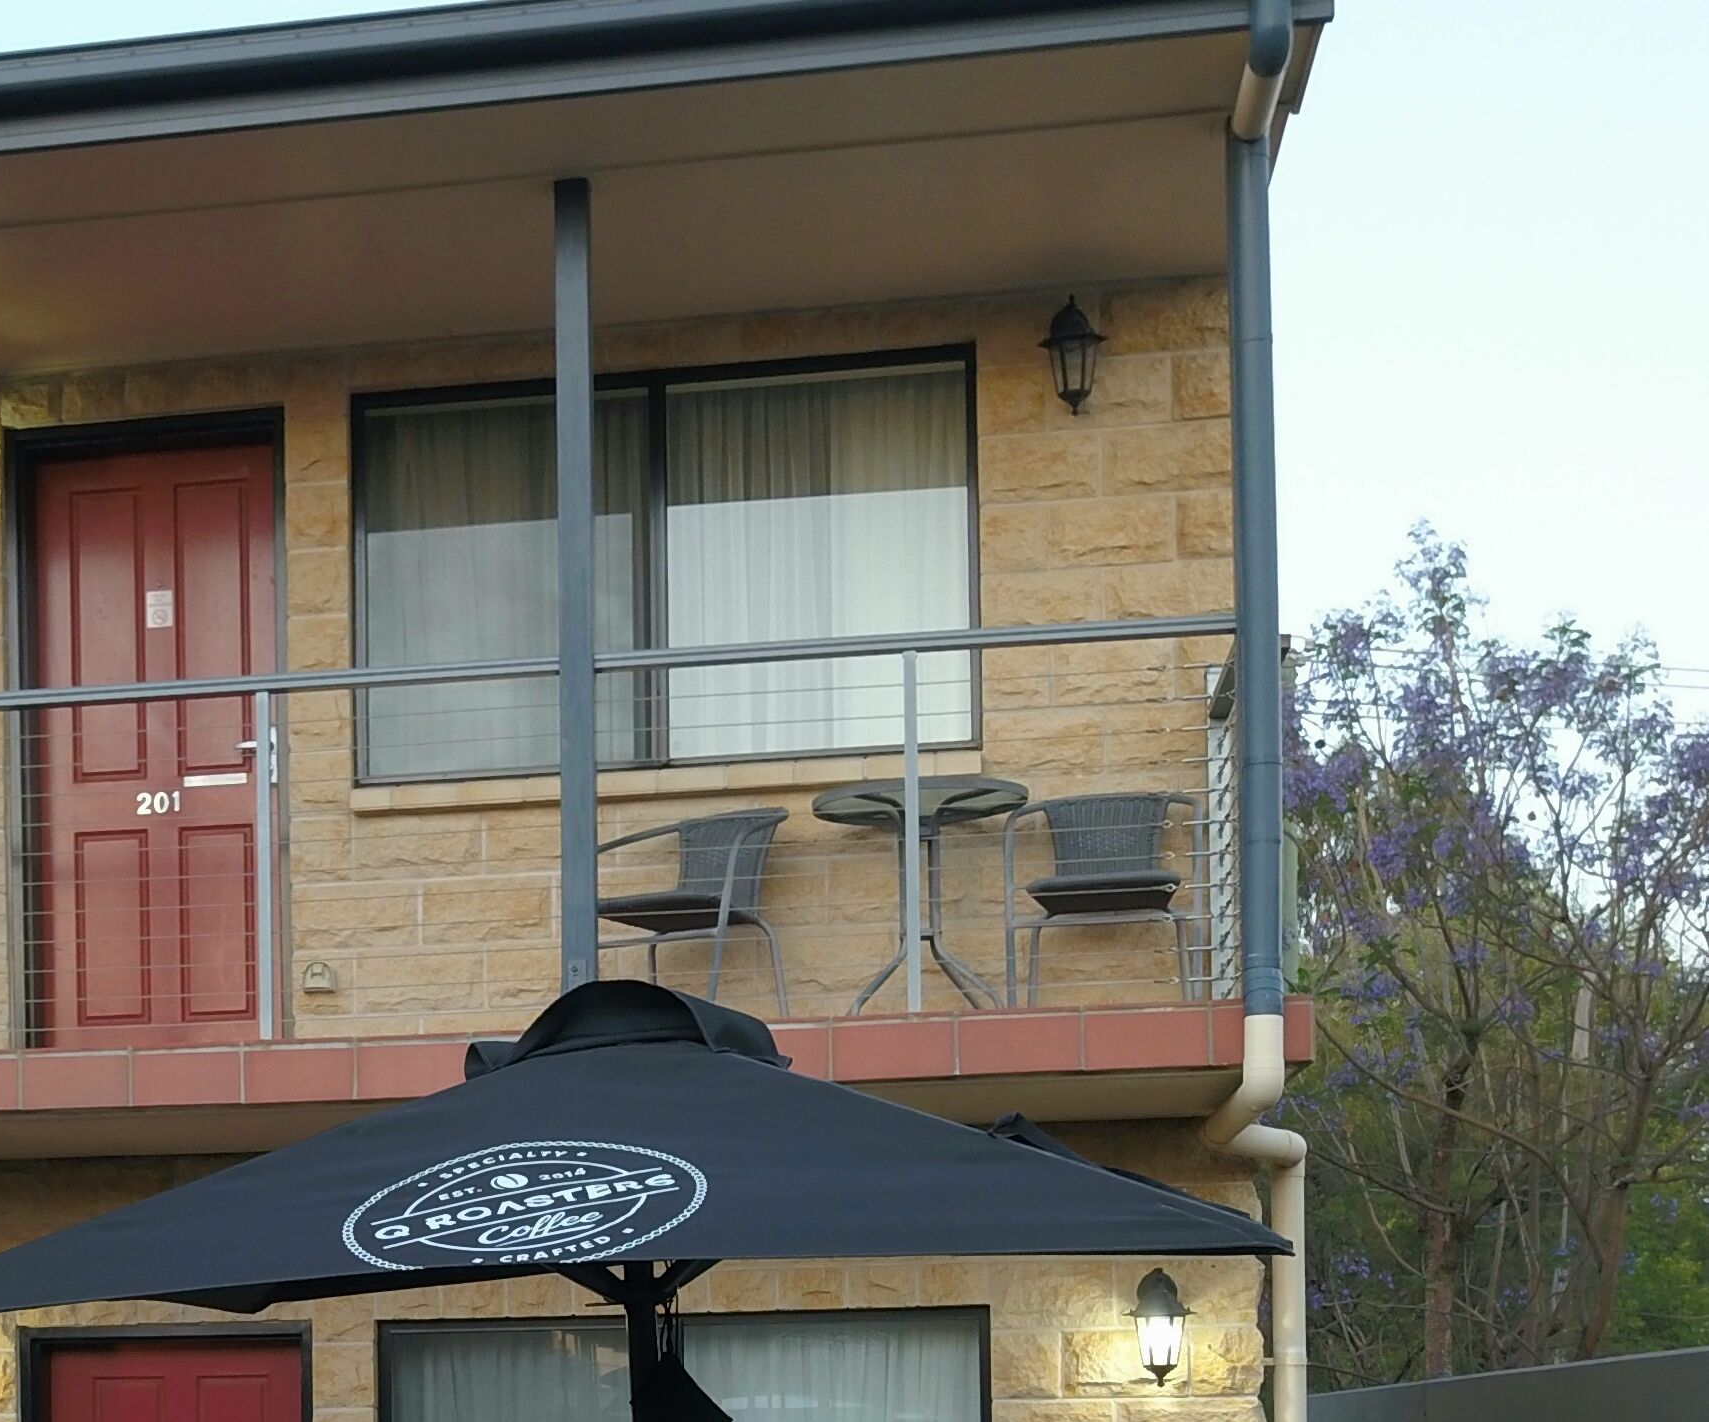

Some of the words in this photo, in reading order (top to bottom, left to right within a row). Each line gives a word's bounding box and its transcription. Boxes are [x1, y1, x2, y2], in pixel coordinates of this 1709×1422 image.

[136, 790, 181, 816] 201
[439, 1150, 568, 1180] SPECIALTY
[438, 1186, 483, 1201] EST.
[538, 1167, 587, 1181] 2014
[374, 1224, 411, 1240] Q
[424, 1174, 676, 1230] ROASTERS
[477, 1211, 604, 1245] Coffee
[499, 1235, 611, 1263] CRAFTED
